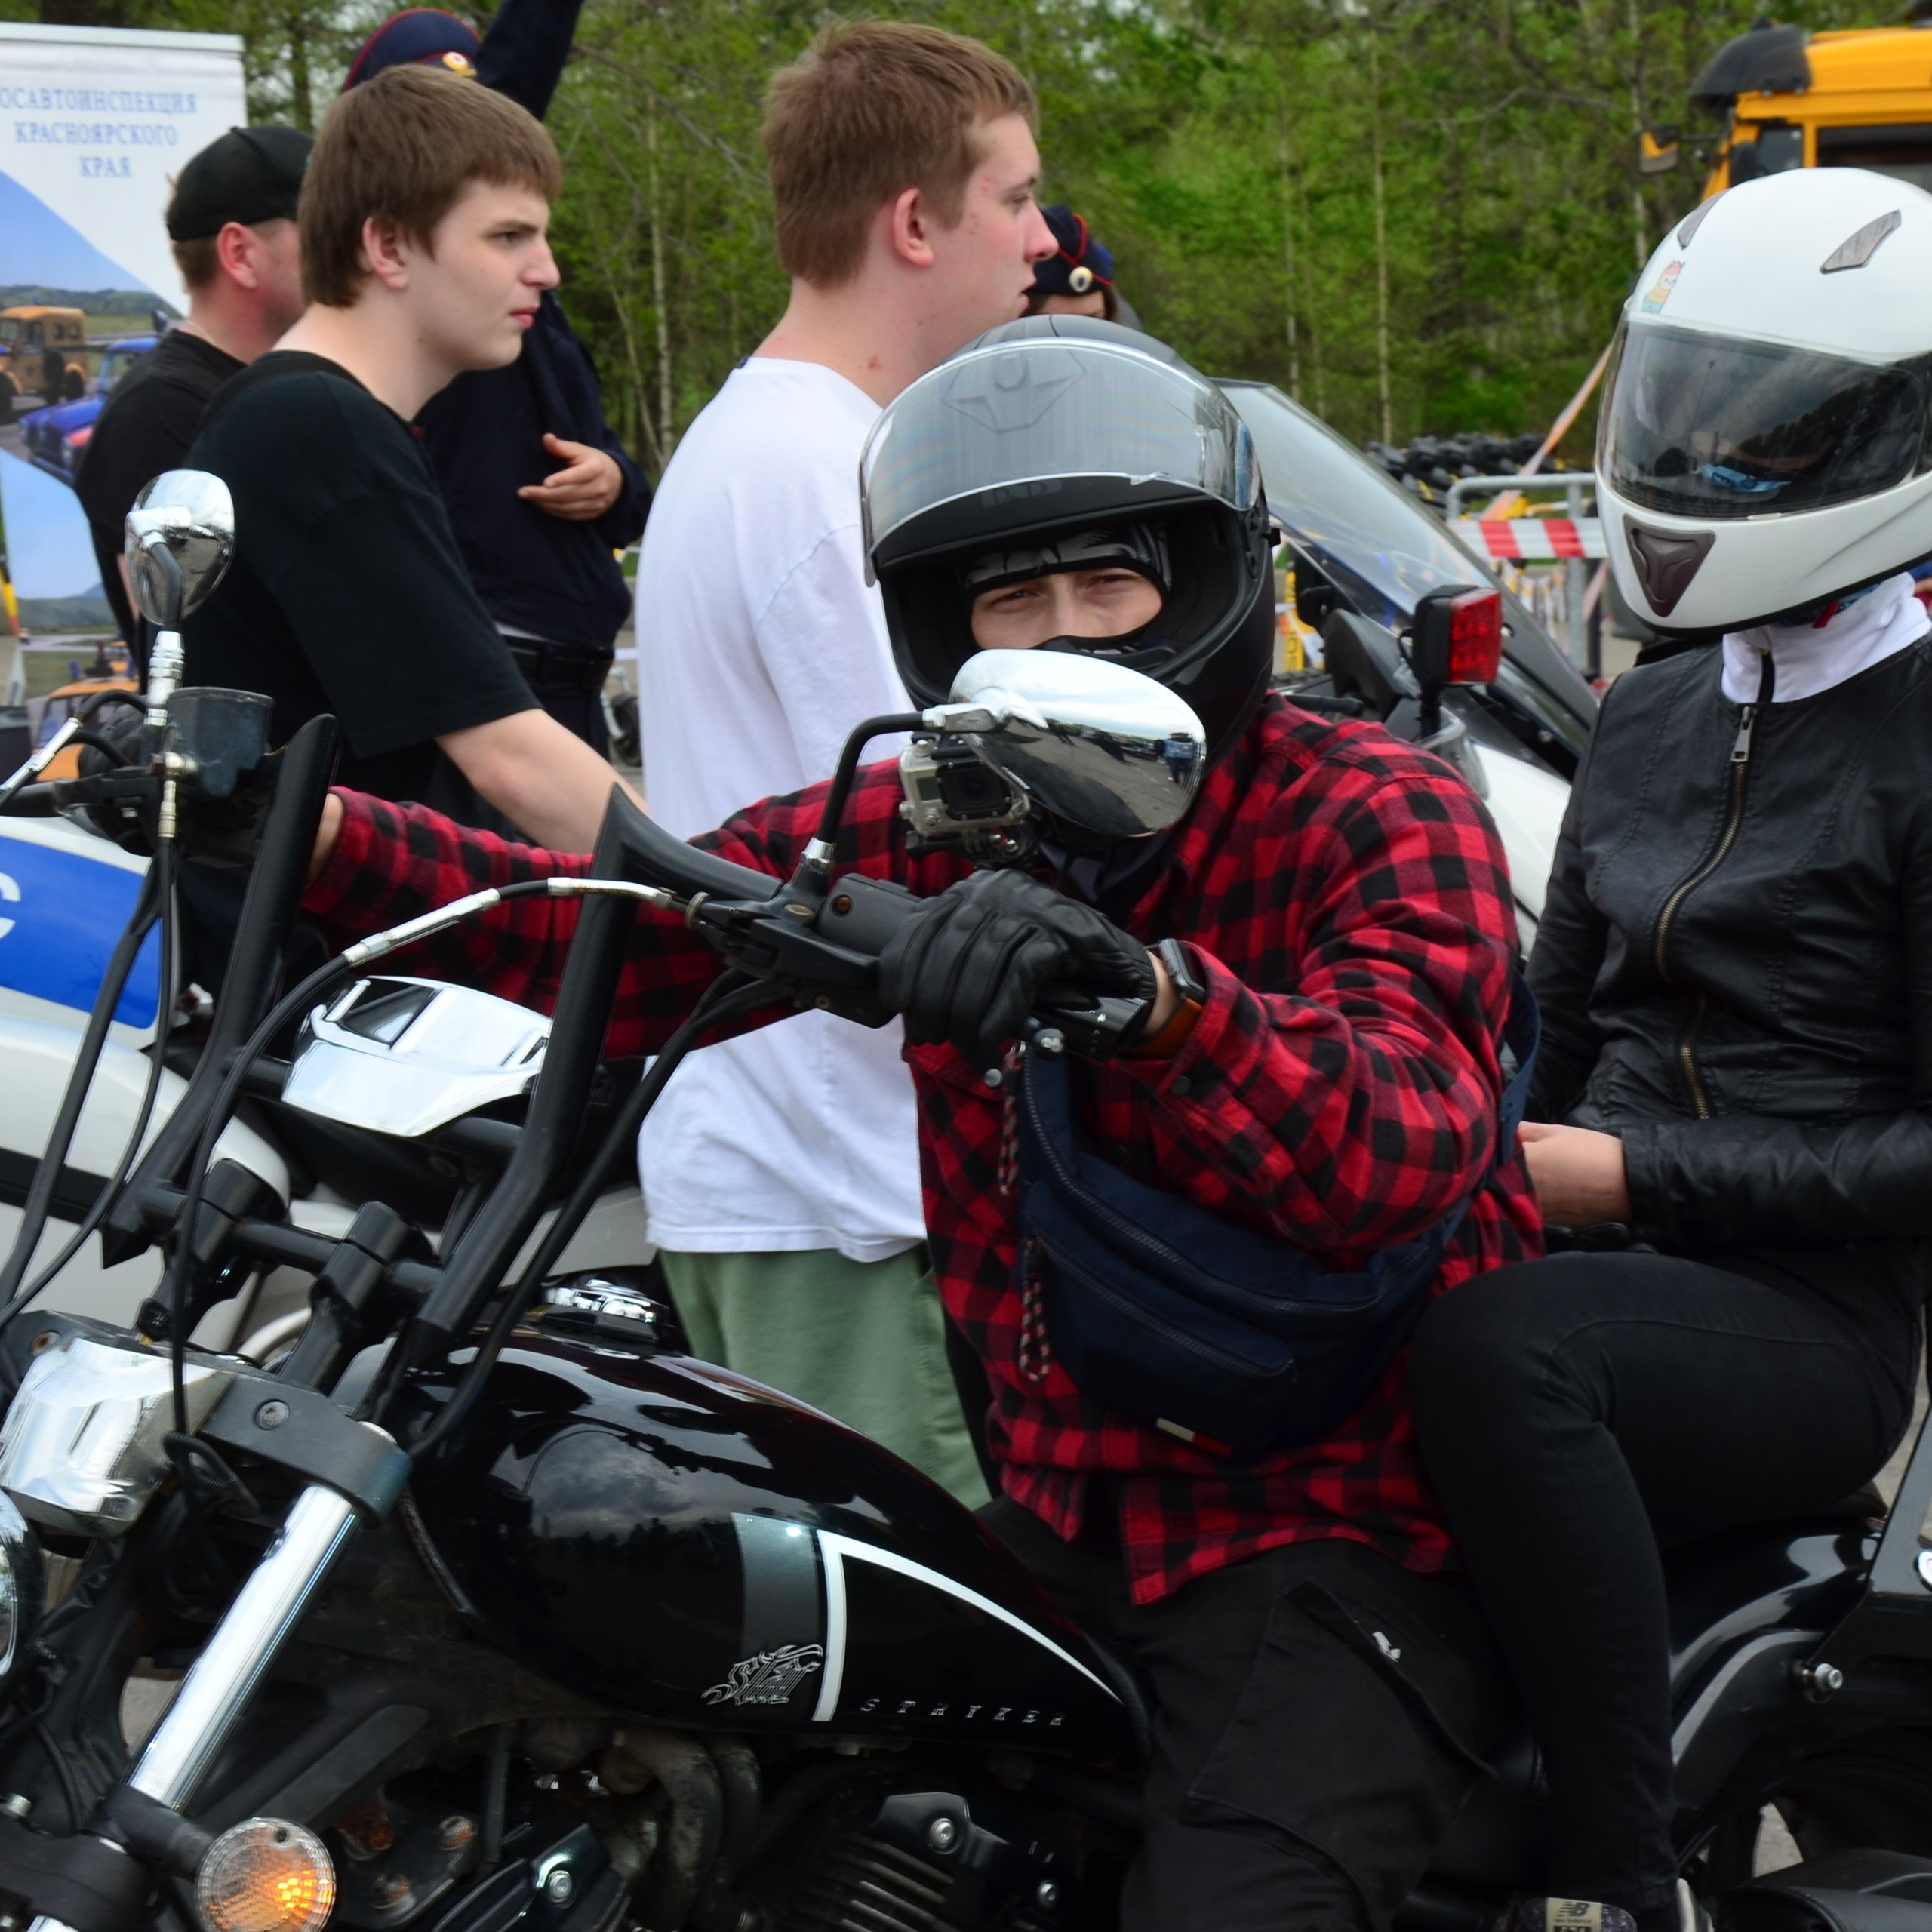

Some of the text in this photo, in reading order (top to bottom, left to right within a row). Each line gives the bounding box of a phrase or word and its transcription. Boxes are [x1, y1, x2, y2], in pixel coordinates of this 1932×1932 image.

[14, 121, 178, 146] КРАСНОЯРСКОГО
[79, 155, 132, 178] КРАЯ
[859, 1697, 1066, 1727] STRYKER
